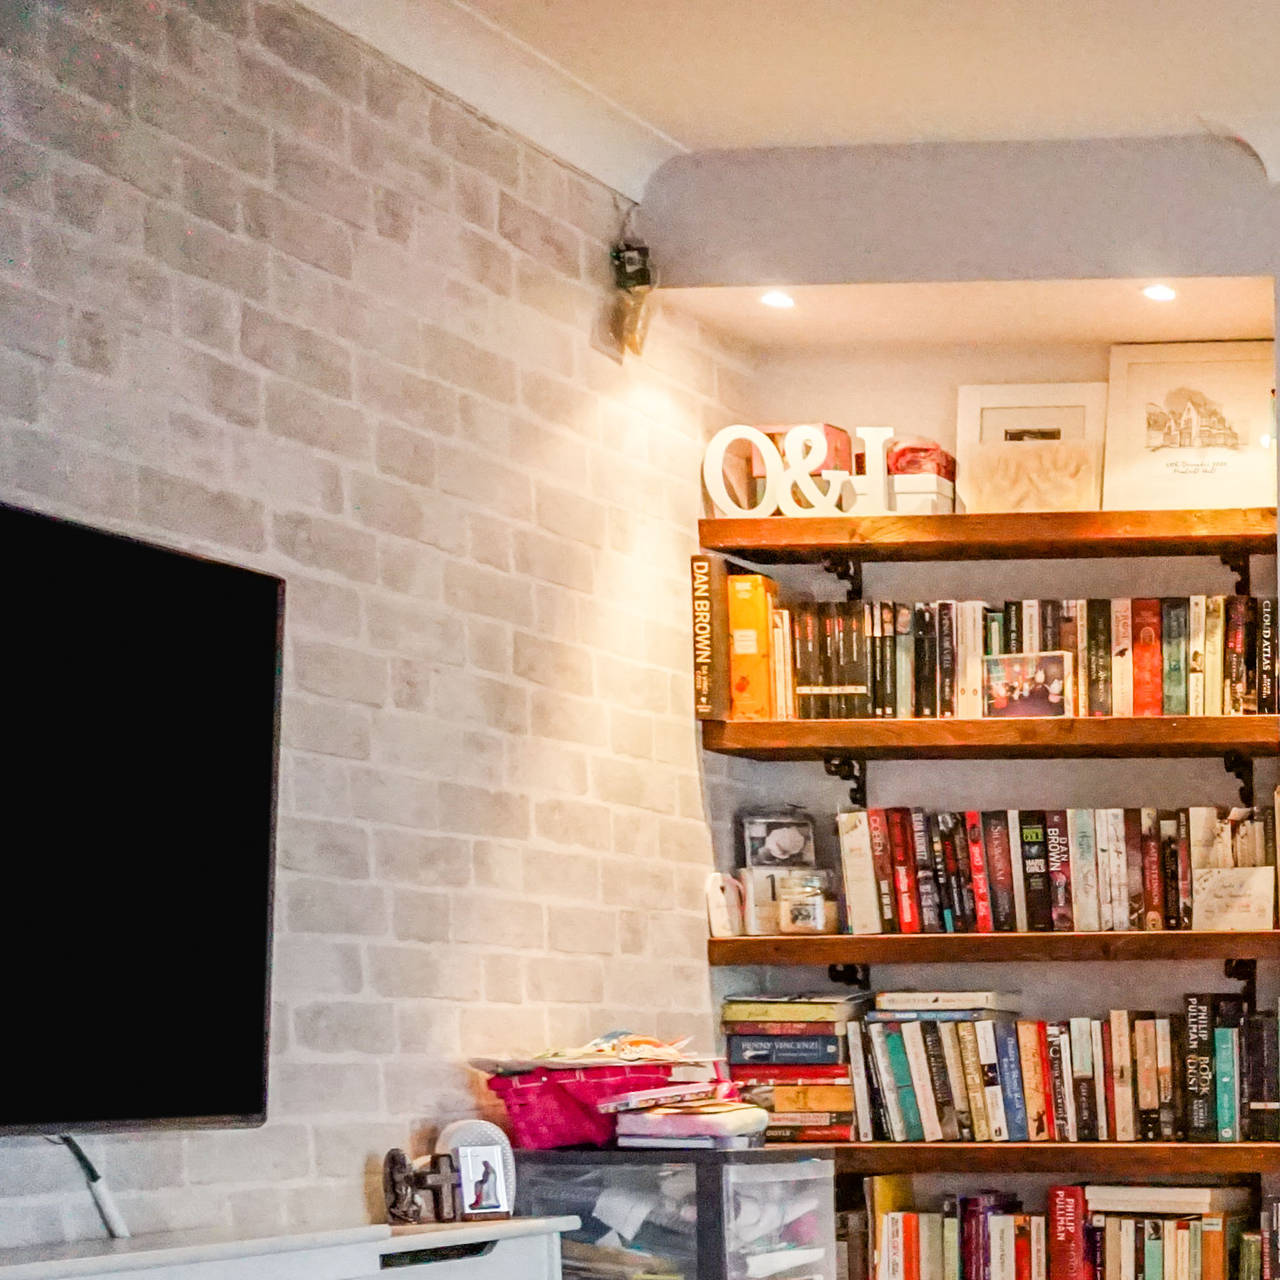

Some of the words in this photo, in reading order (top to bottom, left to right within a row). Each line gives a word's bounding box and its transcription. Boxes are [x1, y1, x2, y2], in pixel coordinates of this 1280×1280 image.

[693, 561, 709, 596] DAN
[695, 600, 712, 663] BROWN
[1262, 600, 1271, 638] CLOUD
[1263, 639, 1271, 671] ATLAS
[870, 817, 883, 856] COBEN
[1048, 828, 1061, 871] BROWN
[1060, 837, 1068, 861] DAN
[1150, 842, 1158, 861] KATE
[766, 874, 778, 901] 1
[1151, 863, 1159, 905] ATKINSON
[1188, 997, 1198, 1048] PULLMAN
[1198, 1006, 1208, 1041] PHILIP
[741, 1041, 772, 1050] PENNY
[774, 1041, 818, 1050] VINCENZI
[1056, 1191, 1065, 1240] PULLMAN
[1065, 1198, 1075, 1232] PHILIP
